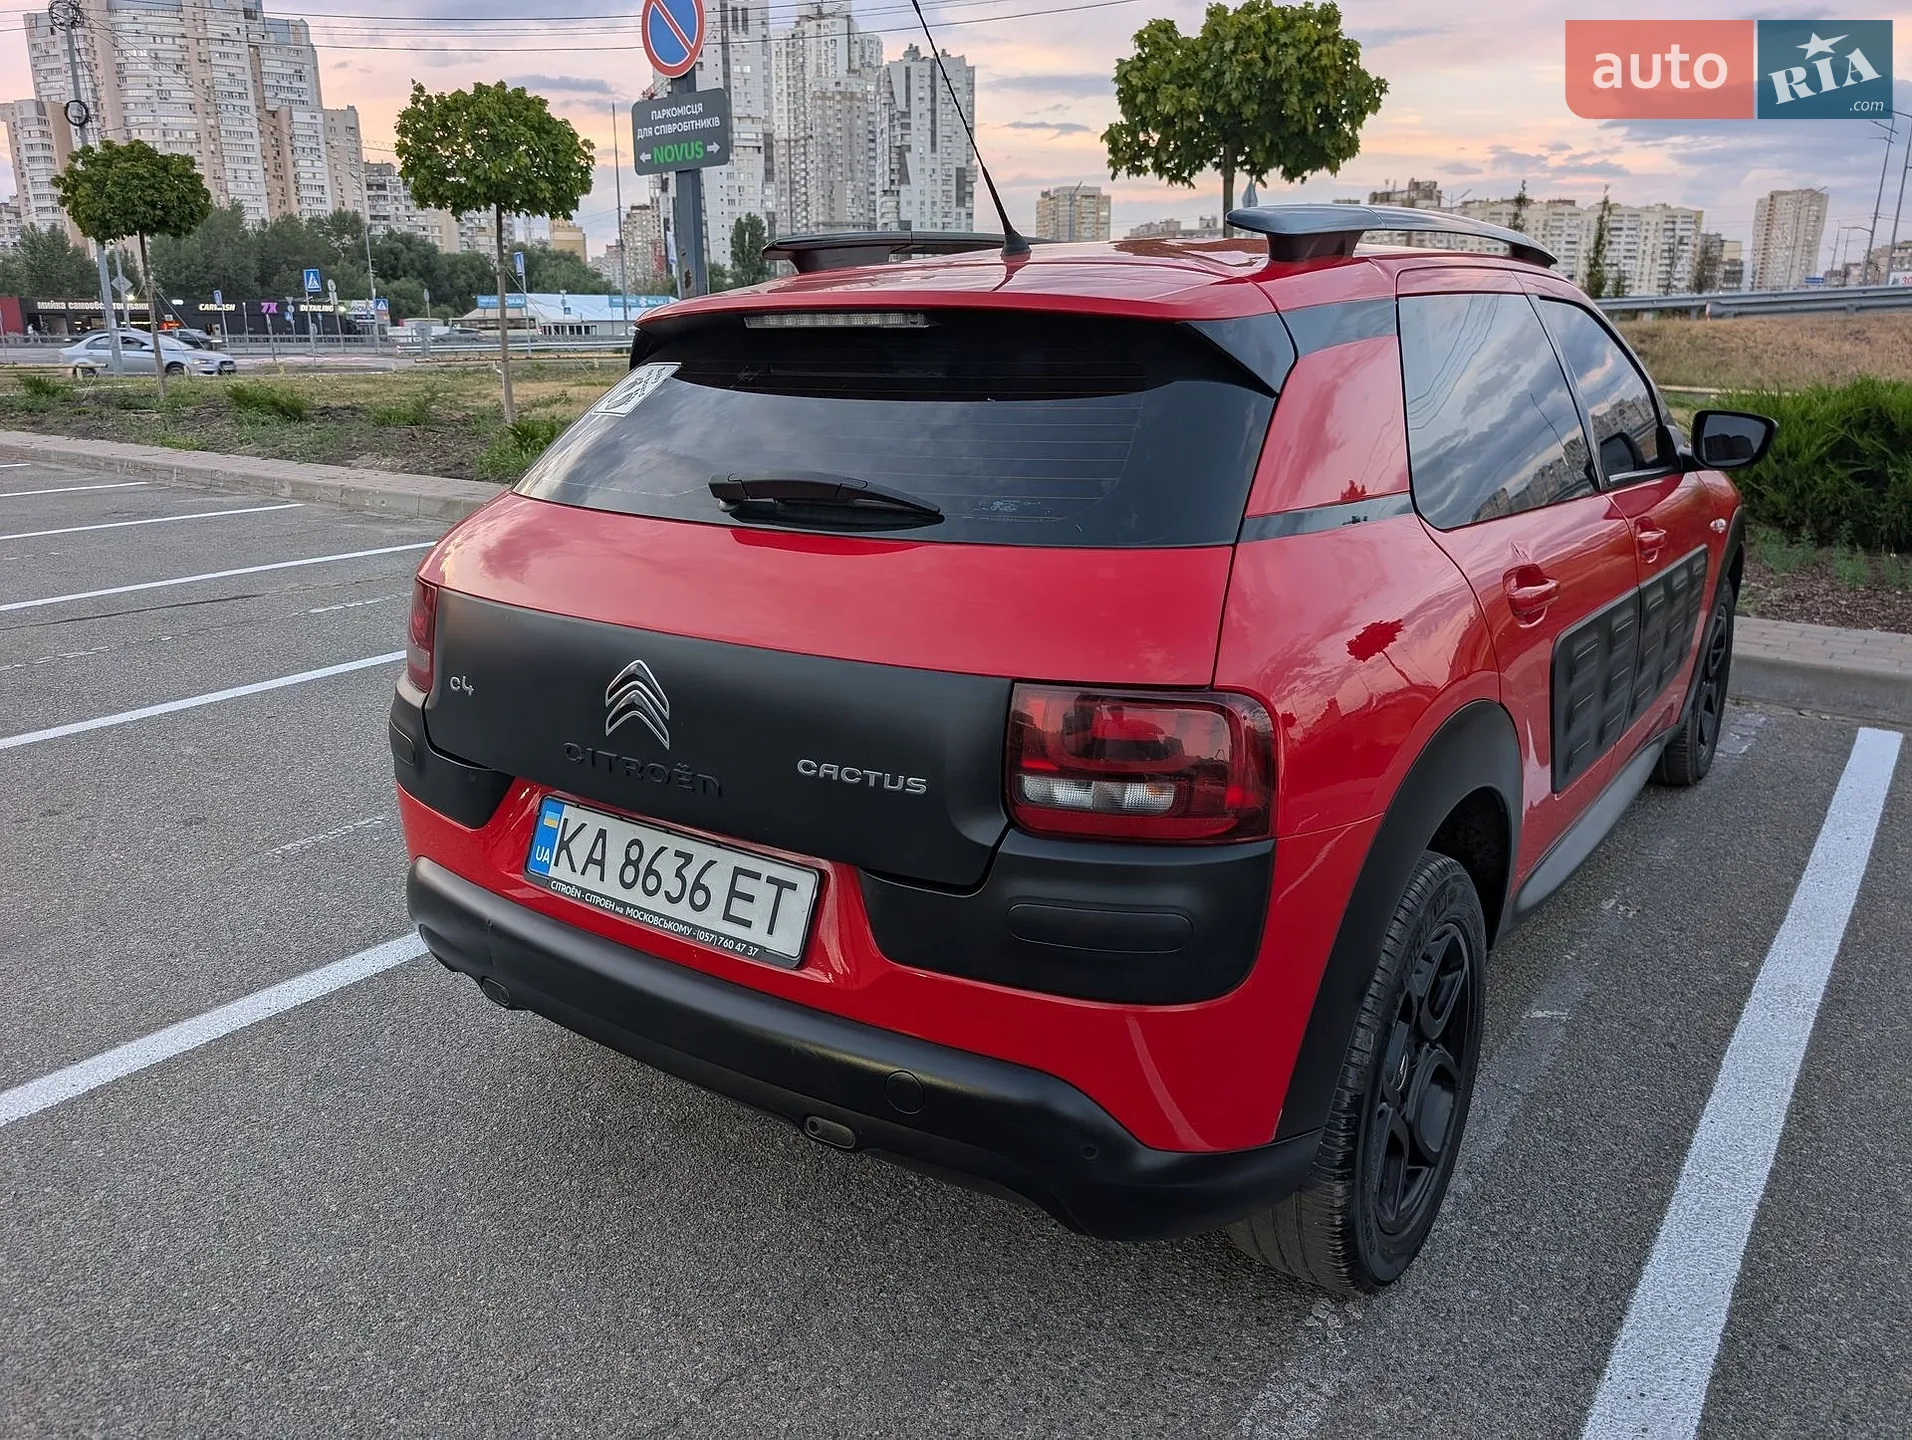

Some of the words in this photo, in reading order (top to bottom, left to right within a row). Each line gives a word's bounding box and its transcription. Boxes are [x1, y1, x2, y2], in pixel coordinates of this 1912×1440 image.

[651, 103, 703, 121] ПАРКОМІСЦЯ
[637, 127, 653, 140] ДЛЯ
[654, 116, 720, 135] СПІВРОБІТНИКІВ
[653, 141, 704, 164] NOVUS
[450, 676, 474, 696] C4
[797, 759, 927, 795] CACTUS
[535, 845, 550, 864] UA
[553, 817, 607, 882] KA
[619, 838, 718, 912] 8636
[722, 866, 798, 936] ET
[625, 907, 692, 936] МОСКОВСЬКОМУ
[717, 936, 734, 949] 760
[735, 943, 747, 953] 47
[747, 945, 759, 957] 37
